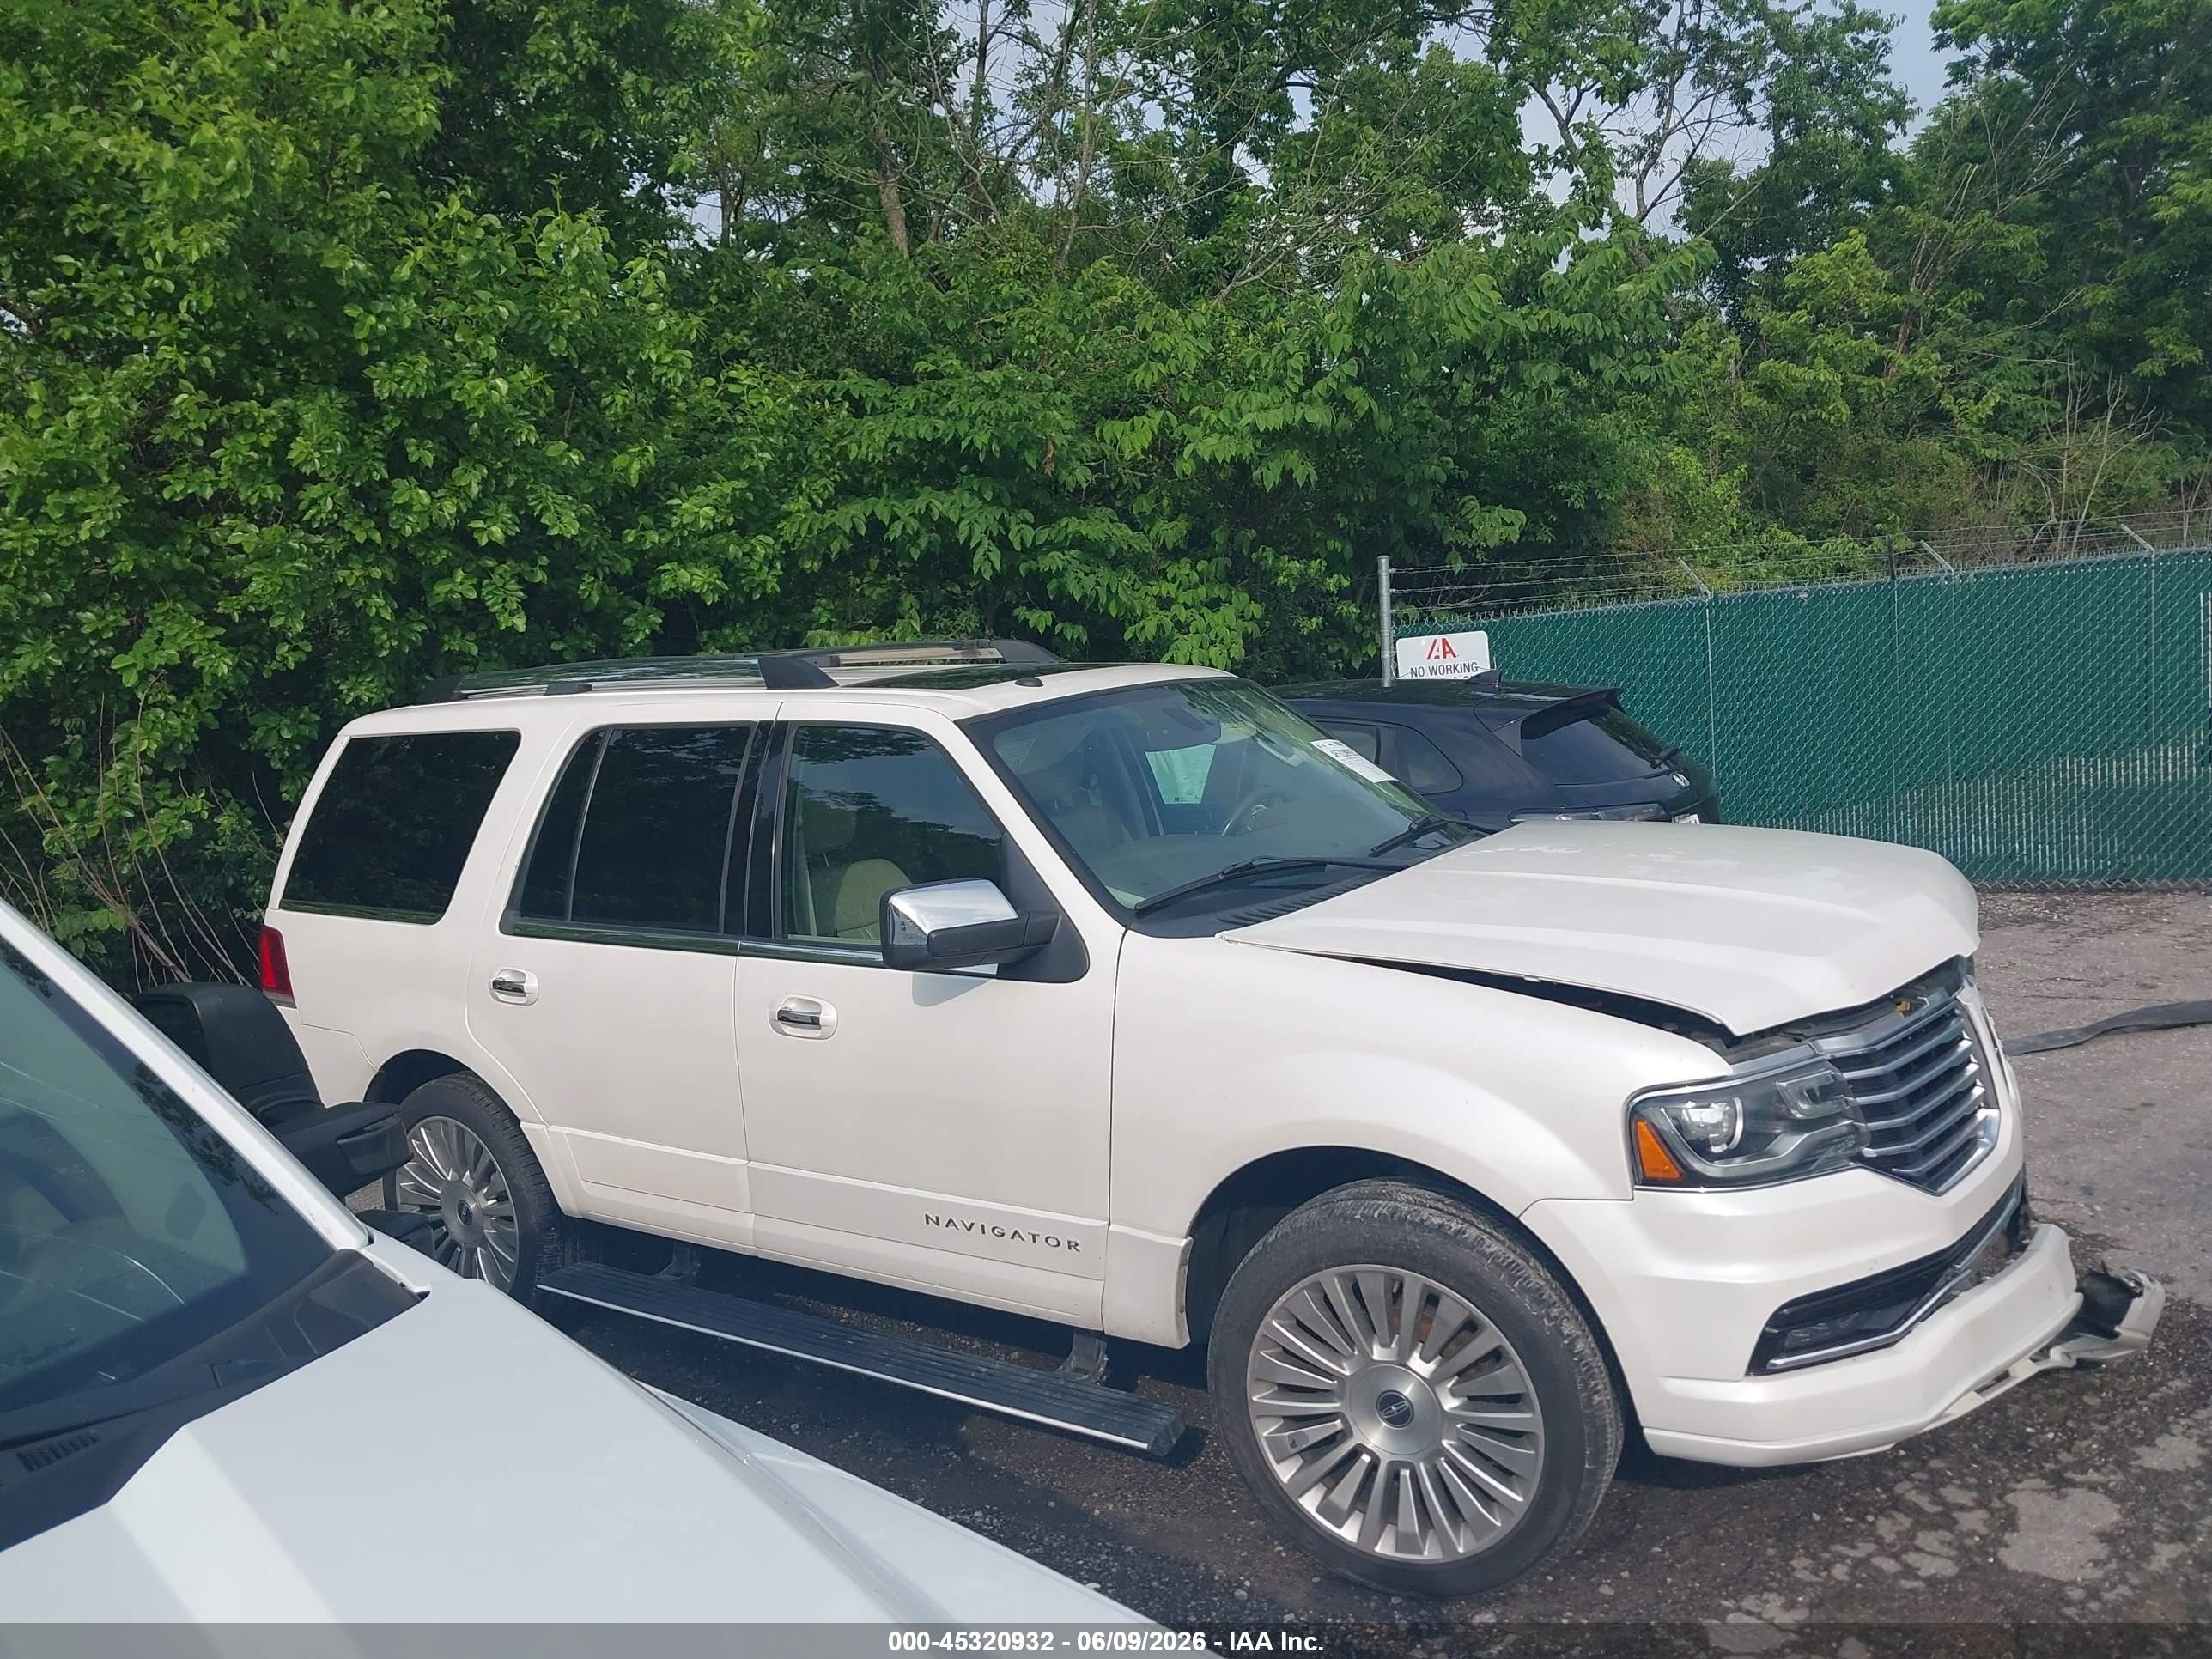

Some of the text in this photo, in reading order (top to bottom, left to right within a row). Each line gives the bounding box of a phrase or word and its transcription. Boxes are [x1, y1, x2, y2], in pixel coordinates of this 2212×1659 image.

[1409, 661, 1479, 678] NO WORKING
[924, 1213, 1081, 1253] NAVIGATOR
